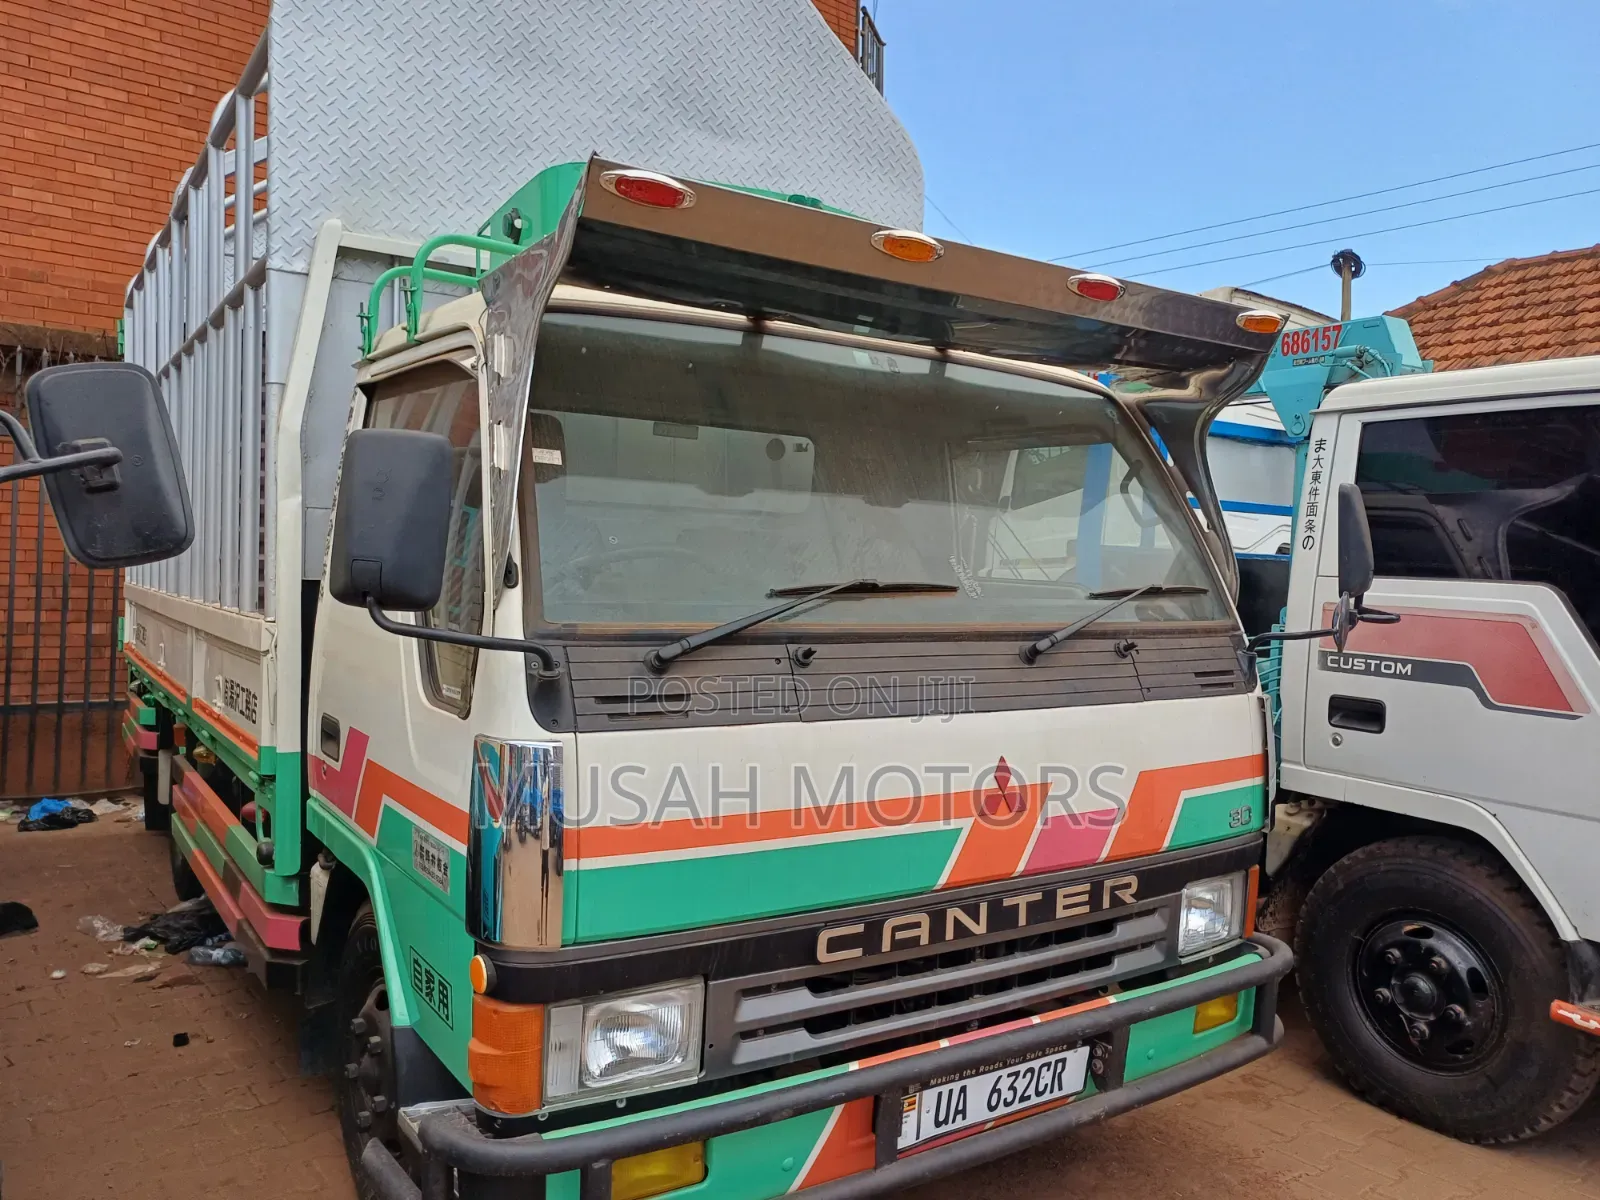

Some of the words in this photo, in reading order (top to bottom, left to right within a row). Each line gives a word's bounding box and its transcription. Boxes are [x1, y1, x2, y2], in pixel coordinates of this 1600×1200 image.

[1281, 324, 1342, 356] 686157
[1326, 654, 1412, 676] CUSTOM
[816, 874, 1139, 964] CANTER
[412, 957, 450, 1022] 自家用
[929, 1072, 960, 1086] Making
[962, 1067, 976, 1077] the
[979, 1061, 1004, 1073] Roads
[1006, 1056, 1023, 1066] Your
[1026, 1050, 1043, 1061] Safe
[1045, 1044, 1068, 1056] Space
[933, 1084, 968, 1129] UA
[986, 1057, 1067, 1113] 632CR
